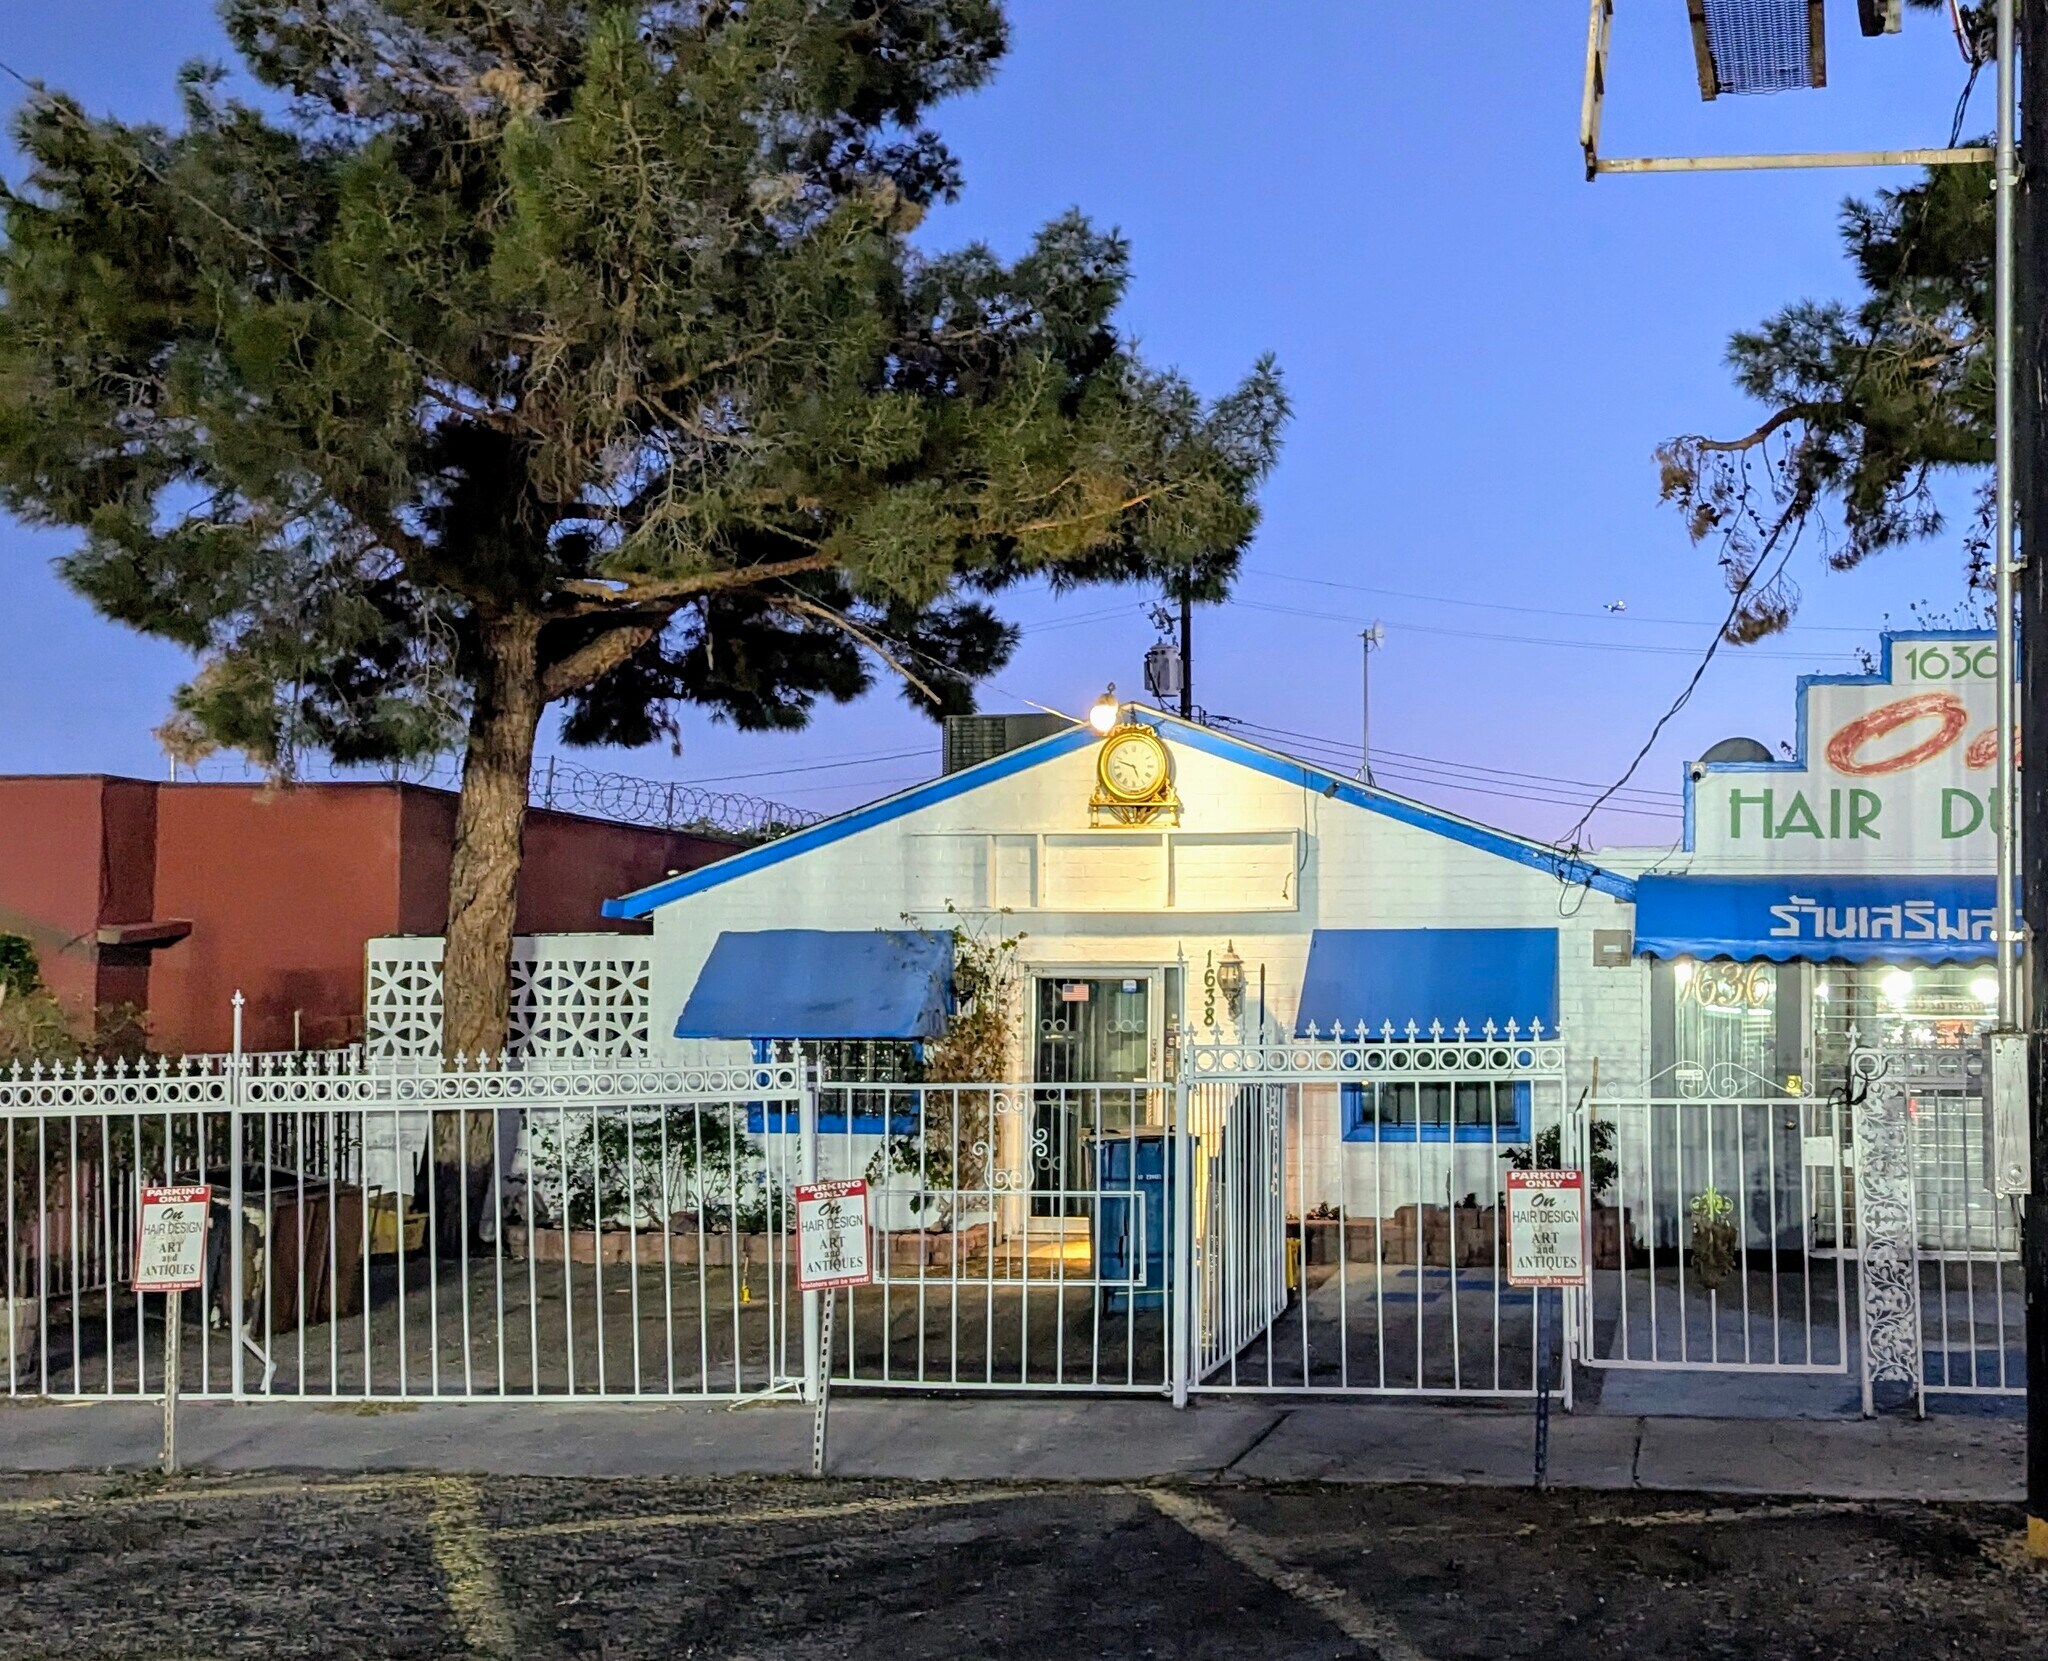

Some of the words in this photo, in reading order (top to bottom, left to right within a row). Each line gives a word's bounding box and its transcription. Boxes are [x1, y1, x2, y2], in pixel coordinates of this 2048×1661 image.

[1905, 645, 1998, 680] 1636
[1729, 788, 1882, 840] HAIR
[1203, 949, 1216, 1027] 1638
[1511, 1172, 1577, 1180] PARKING
[800, 1180, 862, 1194] PARKING
[1525, 1180, 1563, 1188] ONLY
[147, 1187, 205, 1196] PARKING
[814, 1189, 848, 1199] ONLY
[1531, 1193, 1558, 1207] On
[161, 1207, 184, 1220] On
[818, 1203, 842, 1216] On
[802, 1220, 824, 1232] HAIR
[827, 1214, 863, 1229] DESIGN
[1512, 1210, 1537, 1223] HAIR
[1540, 1210, 1579, 1223] DESIGN
[144, 1224, 166, 1235] HAIR
[168, 1222, 202, 1234] DESIGN
[820, 1236, 846, 1250] ART
[1532, 1232, 1559, 1244] ART
[158, 1241, 184, 1253] ART
[824, 1248, 840, 1258] and
[1536, 1244, 1554, 1254] and
[162, 1254, 178, 1262] and
[806, 1256, 863, 1273] ANTIQUES
[1517, 1256, 1577, 1270] ANTIQUES
[144, 1264, 195, 1276] ANTIQUES
